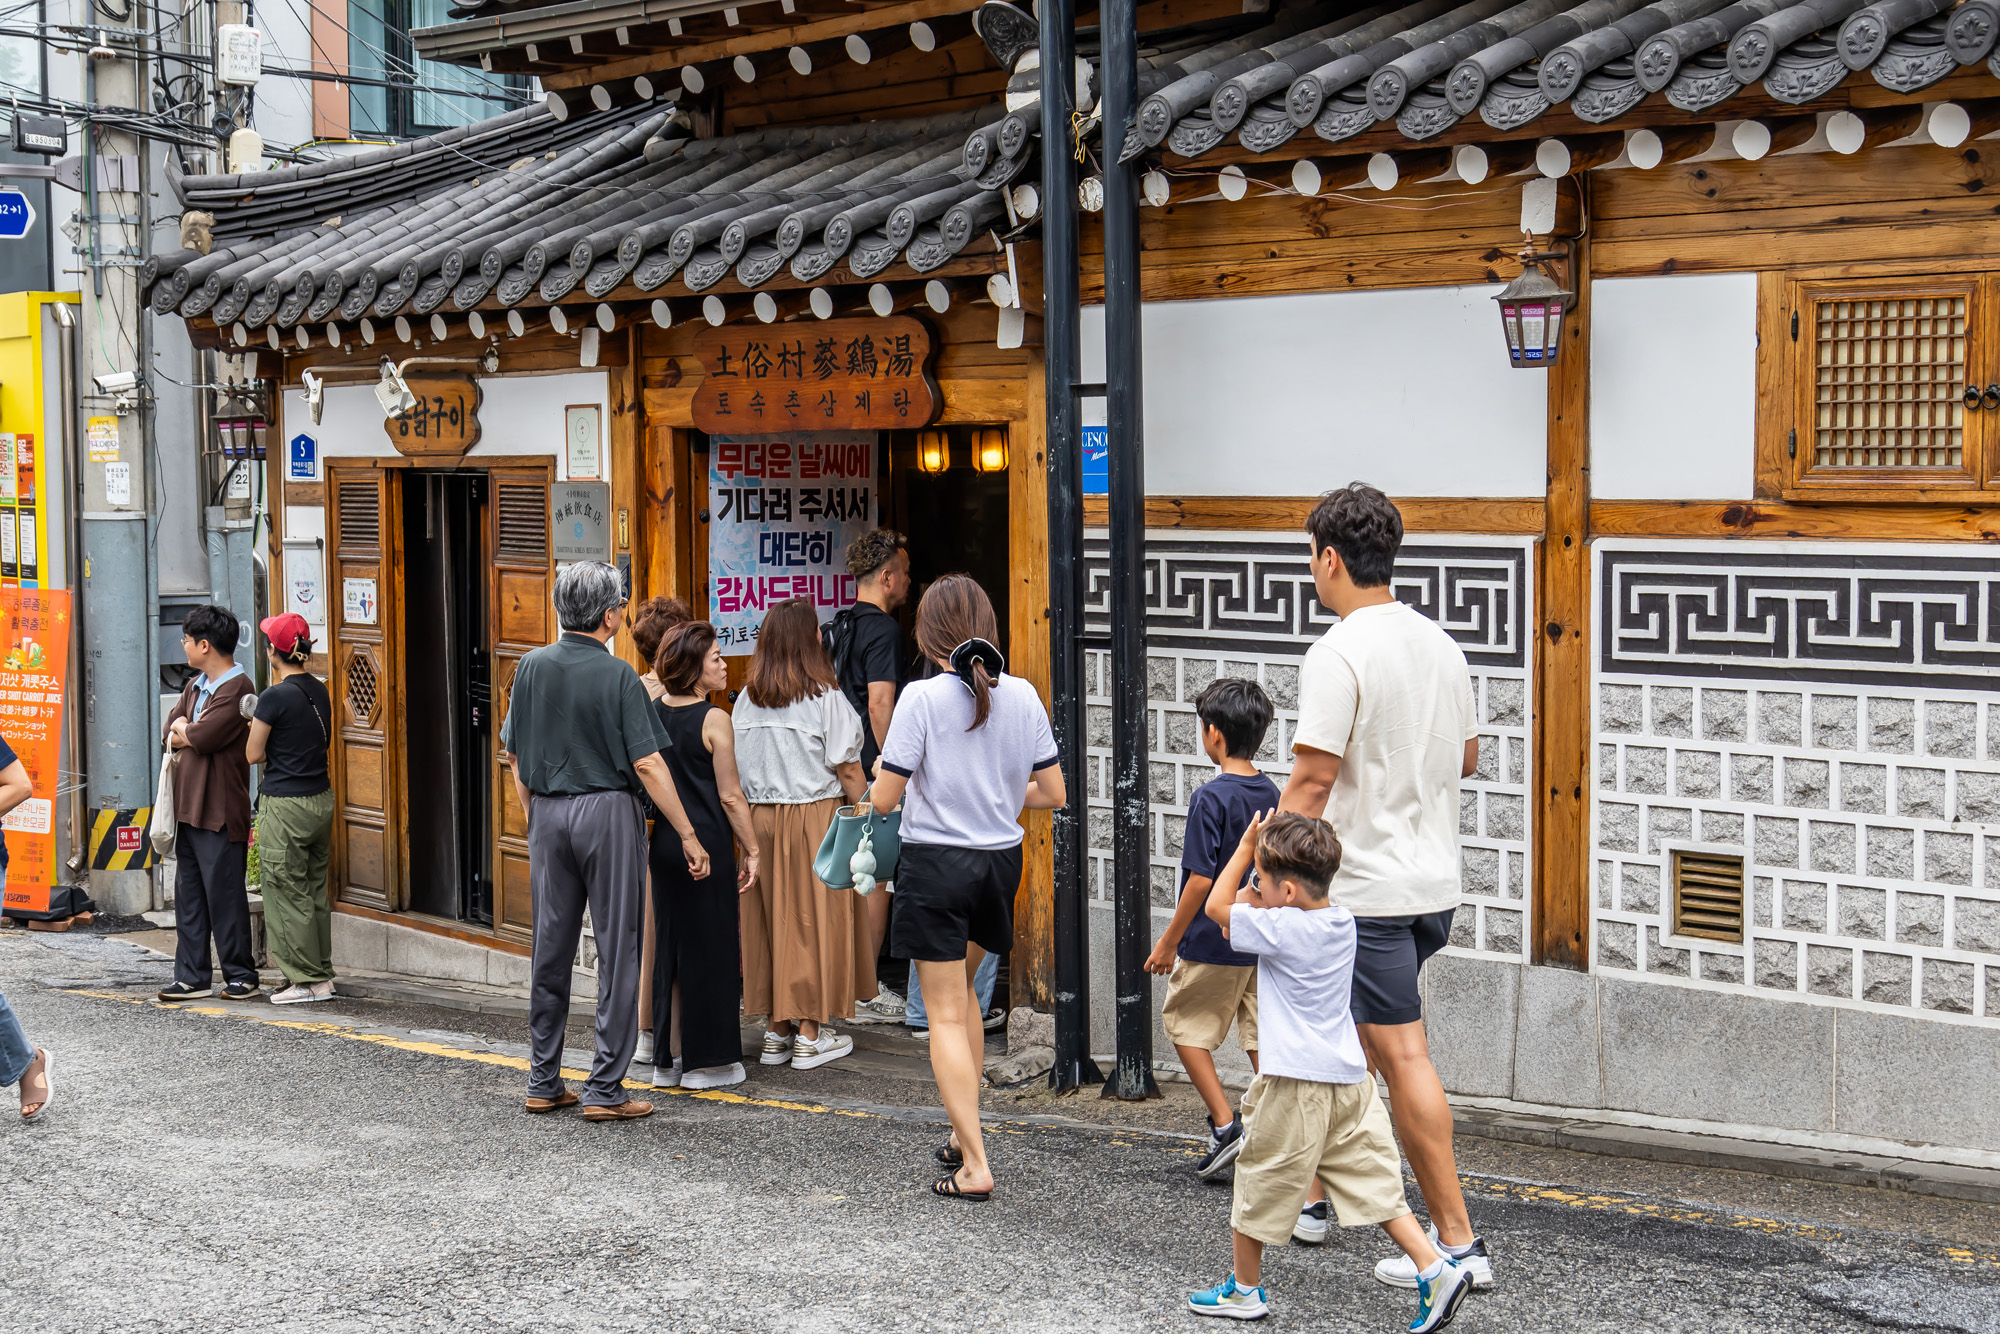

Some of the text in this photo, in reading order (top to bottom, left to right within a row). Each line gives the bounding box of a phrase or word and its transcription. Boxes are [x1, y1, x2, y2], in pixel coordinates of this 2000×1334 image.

[300, 441, 306, 458] 5
[1091, 448, 1108, 461] Memb
[717, 443, 871, 479] 무더운 날씨에
[235, 474, 248, 485] 22
[717, 487, 869, 523] 기다려 주셔서
[759, 531, 833, 566] 대단히
[13, 598, 50, 613] 하루종일
[12, 616, 48, 631] 활력충전
[0, 672, 19, 688] 저샷
[8, 691, 22, 701] SHOT
[22, 692, 45, 702] CARROT
[45, 694, 62, 704] JUICE
[0, 730, 47, 741] ャロットジュース
